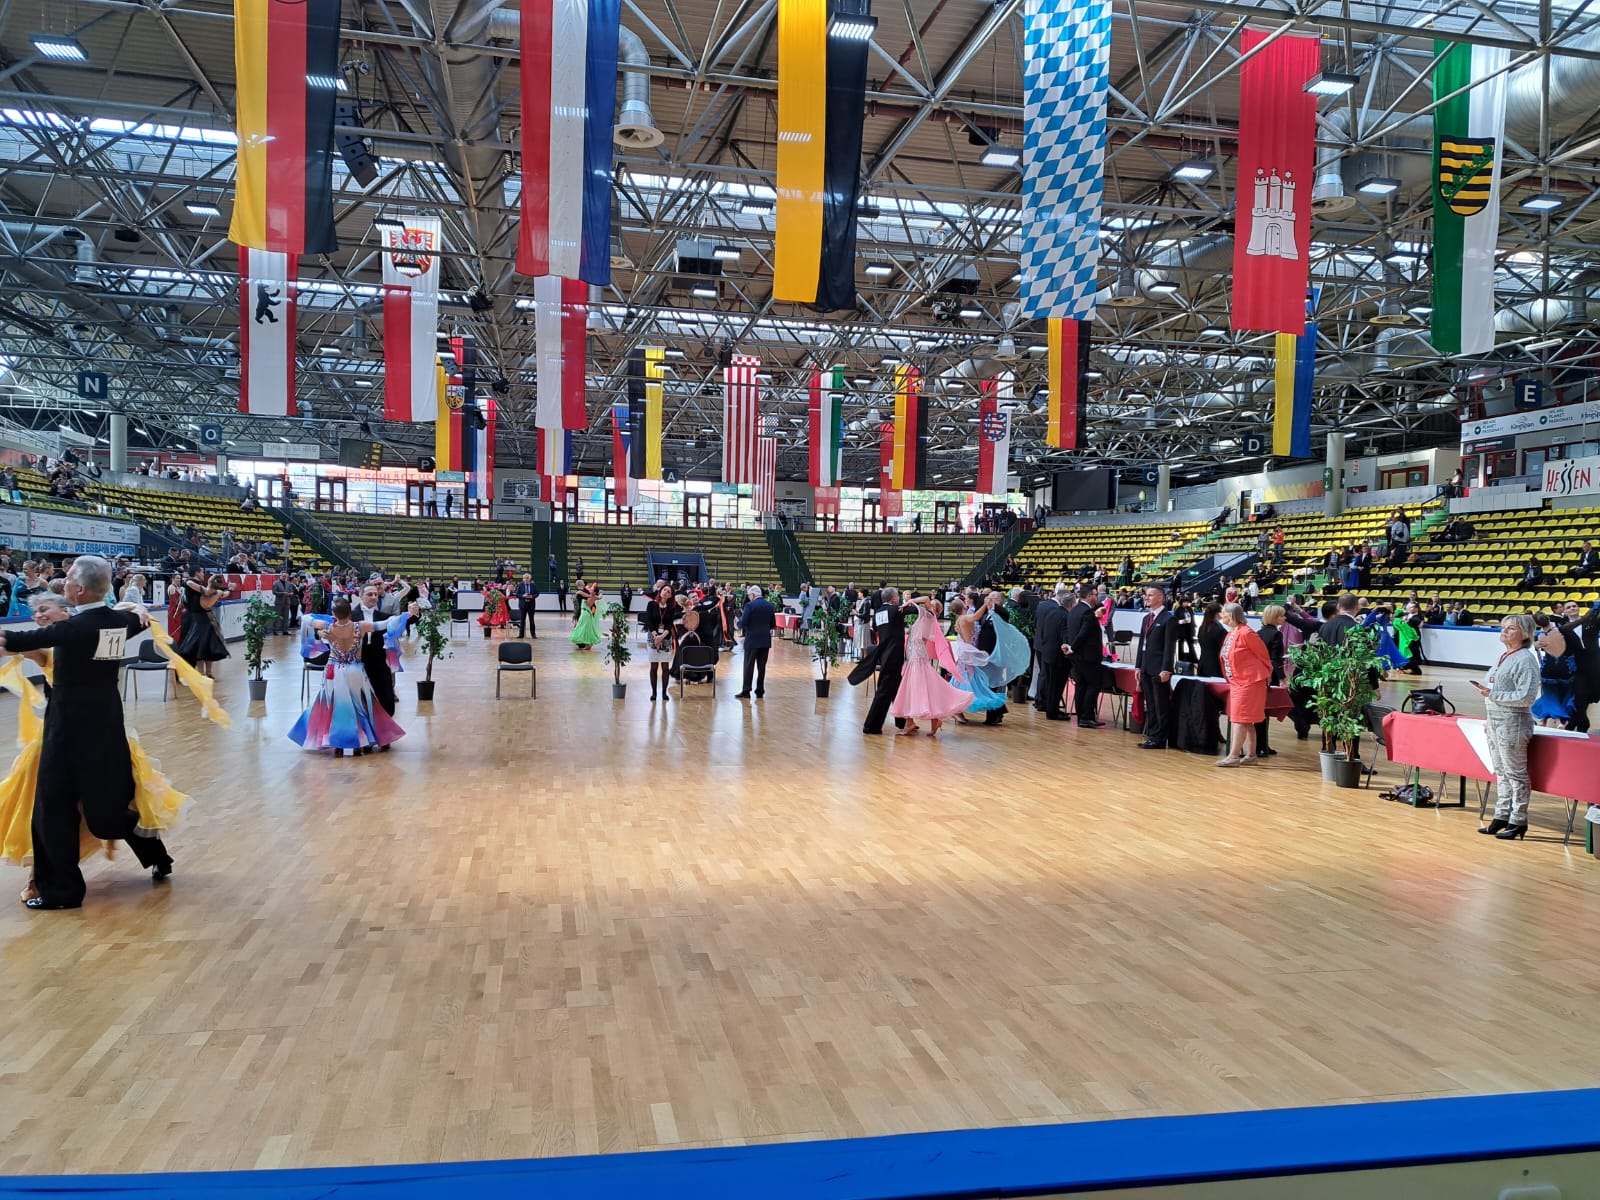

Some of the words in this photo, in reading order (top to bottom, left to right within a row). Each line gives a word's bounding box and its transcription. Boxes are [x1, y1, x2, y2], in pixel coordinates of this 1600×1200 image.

[85, 377, 99, 392] N
[1524, 385, 1536, 402] E
[1511, 422, 1534, 430] Kingspan
[205, 429, 216, 440] O
[1249, 439, 1260, 451] D
[421, 460, 430, 469] P
[667, 472, 676, 480] A
[1147, 472, 1156, 481] C
[75, 542, 85, 553] DIE
[108, 635, 120, 656] 11
